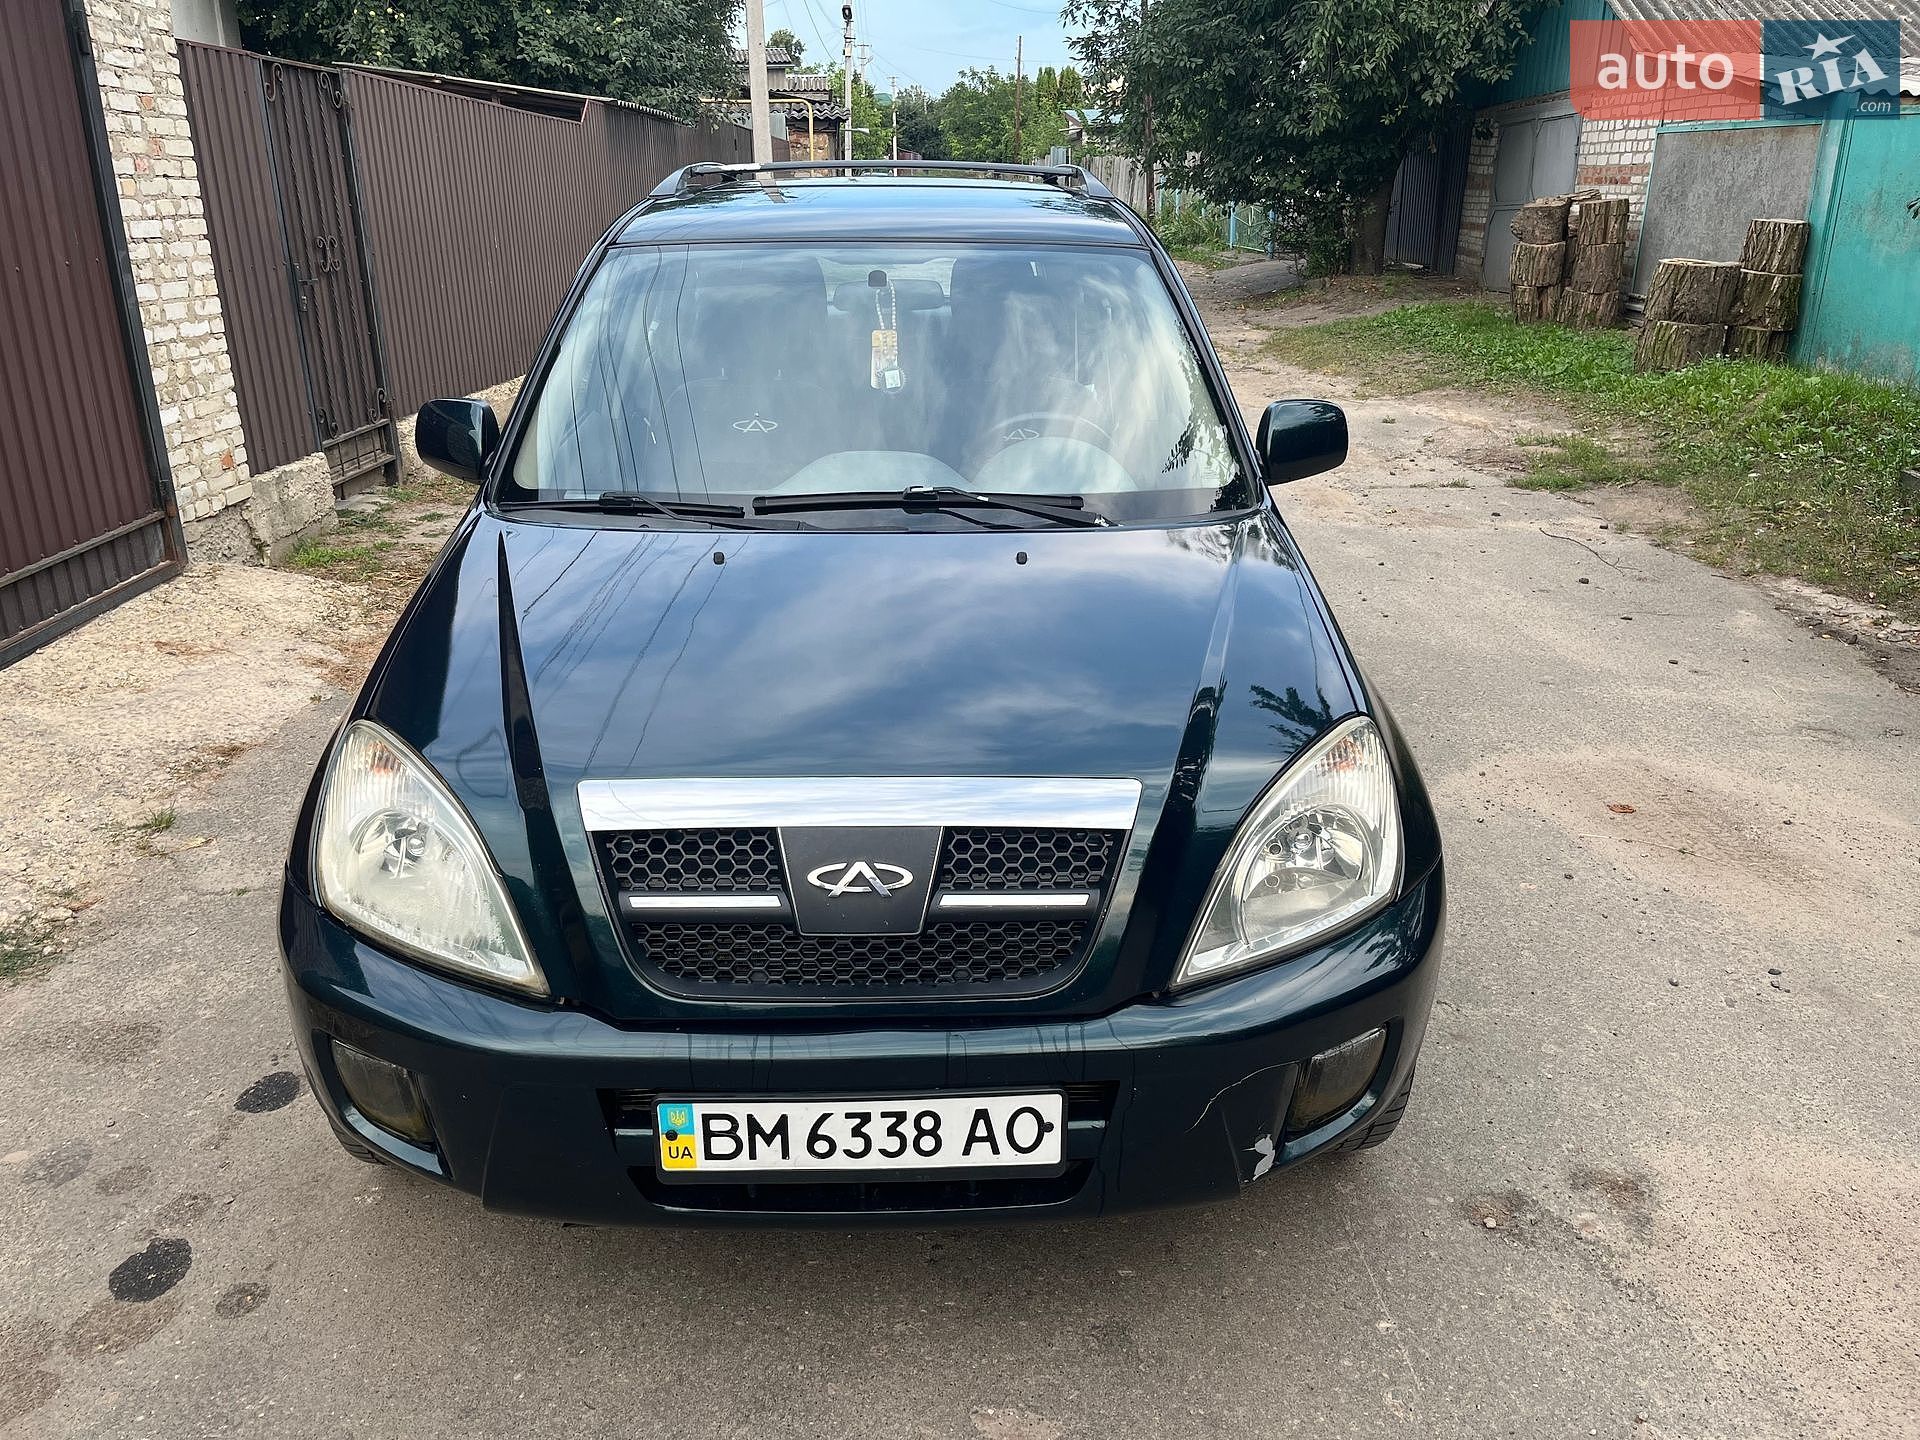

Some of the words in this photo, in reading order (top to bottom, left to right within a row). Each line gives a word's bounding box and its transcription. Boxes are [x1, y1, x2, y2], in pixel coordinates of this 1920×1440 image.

[701, 1113, 790, 1161] BM
[806, 1110, 942, 1160] 6338
[962, 1106, 1046, 1157] AO
[668, 1146, 694, 1160] UA
